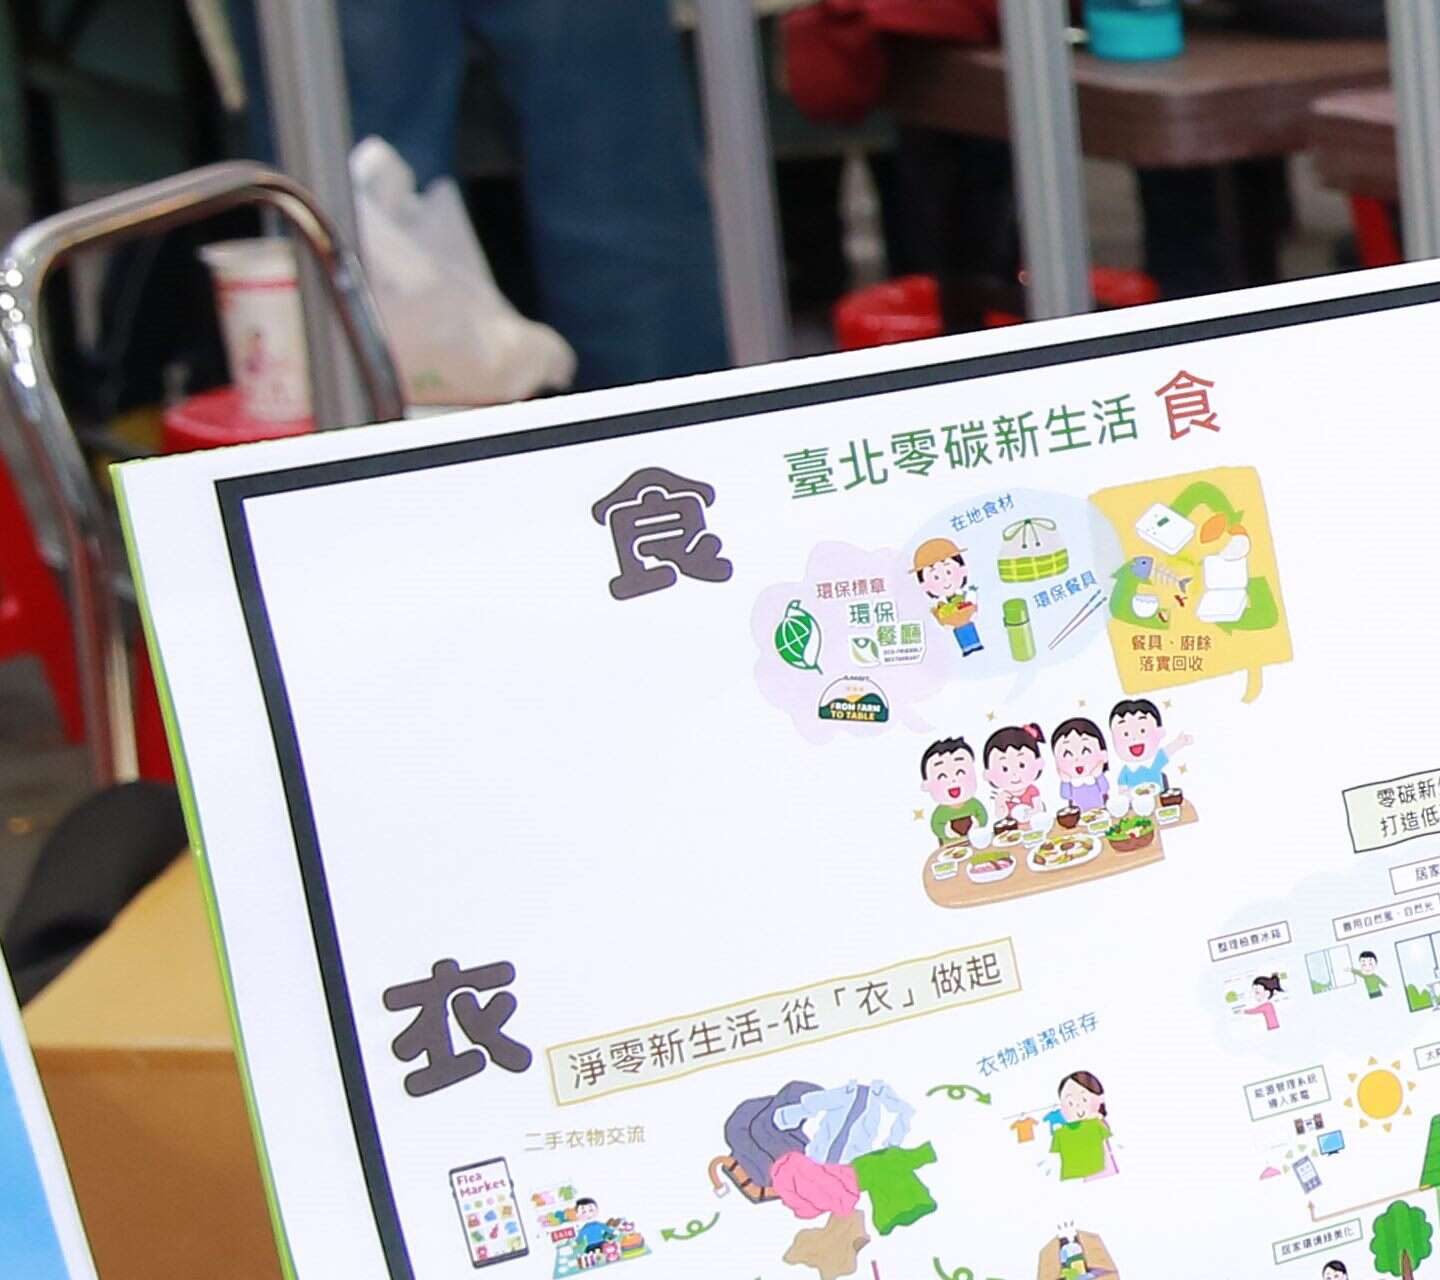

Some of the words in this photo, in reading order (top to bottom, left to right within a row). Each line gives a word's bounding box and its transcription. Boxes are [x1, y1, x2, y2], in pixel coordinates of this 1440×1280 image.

[783, 393, 1139, 500] 臺北零碳新生活
[1155, 370, 1221, 441] 食
[950, 493, 1015, 532] 在地食材
[592, 467, 733, 601] 食
[816, 577, 886, 599] 環保標章
[1033, 570, 1098, 609] 環保餐具
[849, 601, 894, 624] 環保
[877, 623, 922, 646] 餐廳
[1139, 655, 1204, 672] 落實回收
[383, 958, 532, 1097] 衣
[977, 1010, 1099, 1077] 衣物清潔保存
[524, 1125, 646, 1152] 二手衣物交流
[457, 1173, 482, 1186] Flea
[460, 1179, 506, 1198] Market
